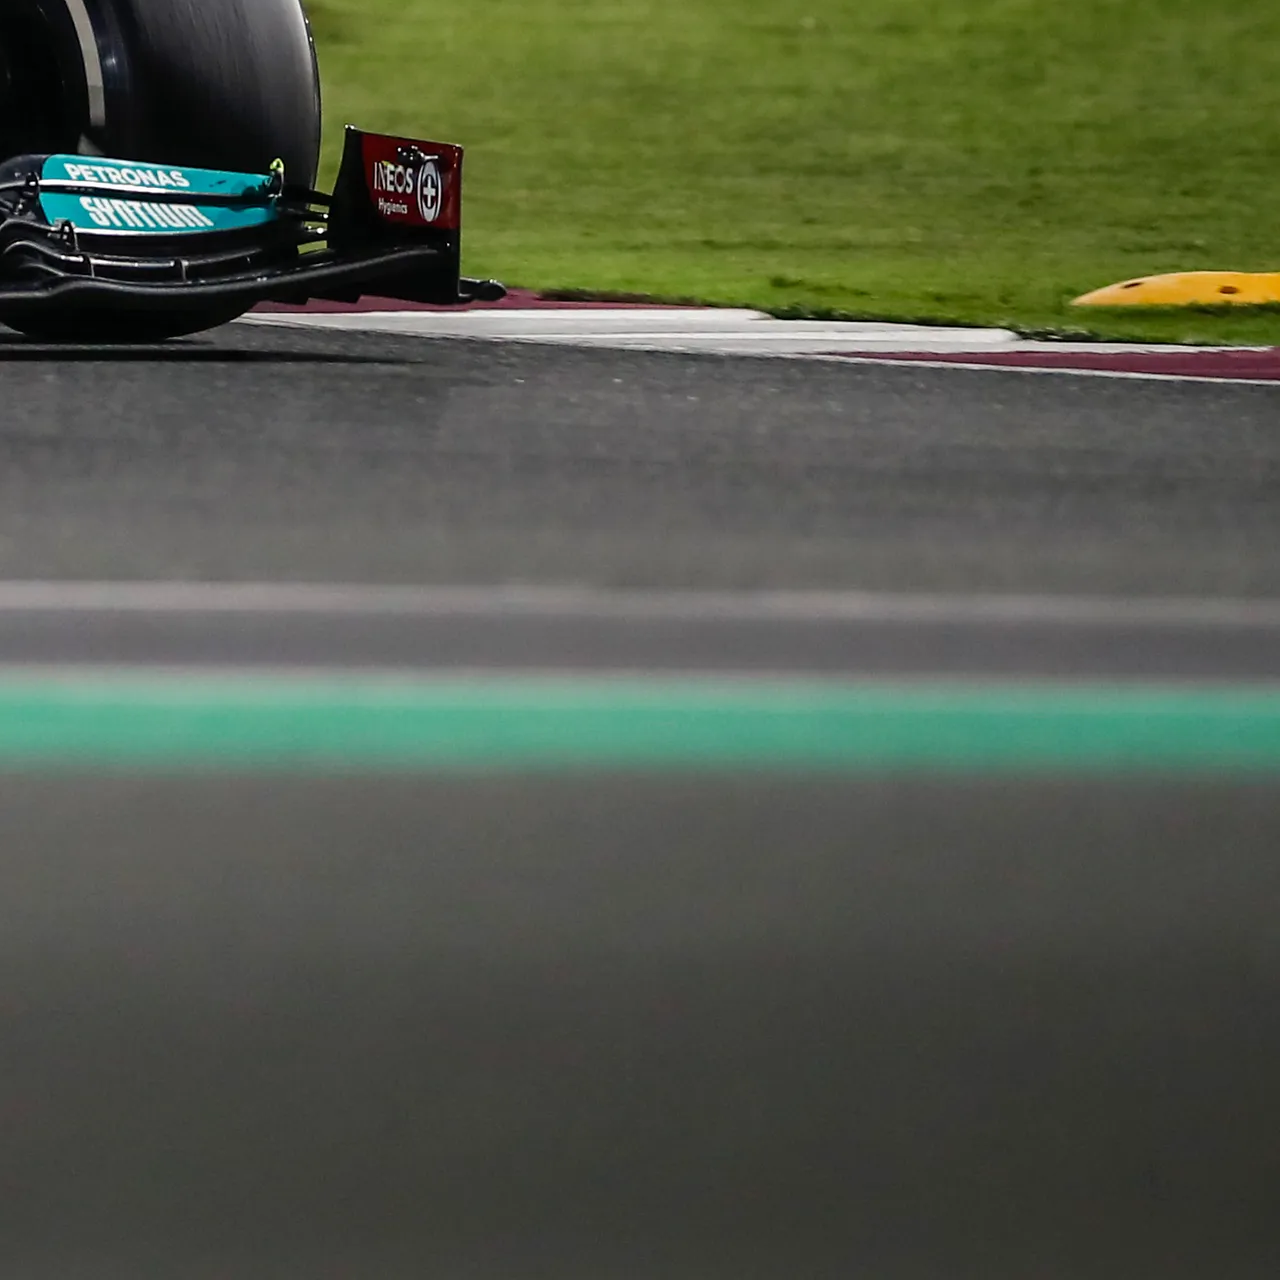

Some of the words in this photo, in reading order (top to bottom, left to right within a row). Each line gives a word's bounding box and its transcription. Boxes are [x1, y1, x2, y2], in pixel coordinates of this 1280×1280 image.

[63, 162, 191, 188] PETRONAS
[373, 160, 414, 194] INEOS
[79, 195, 215, 228] SYNTIUM
